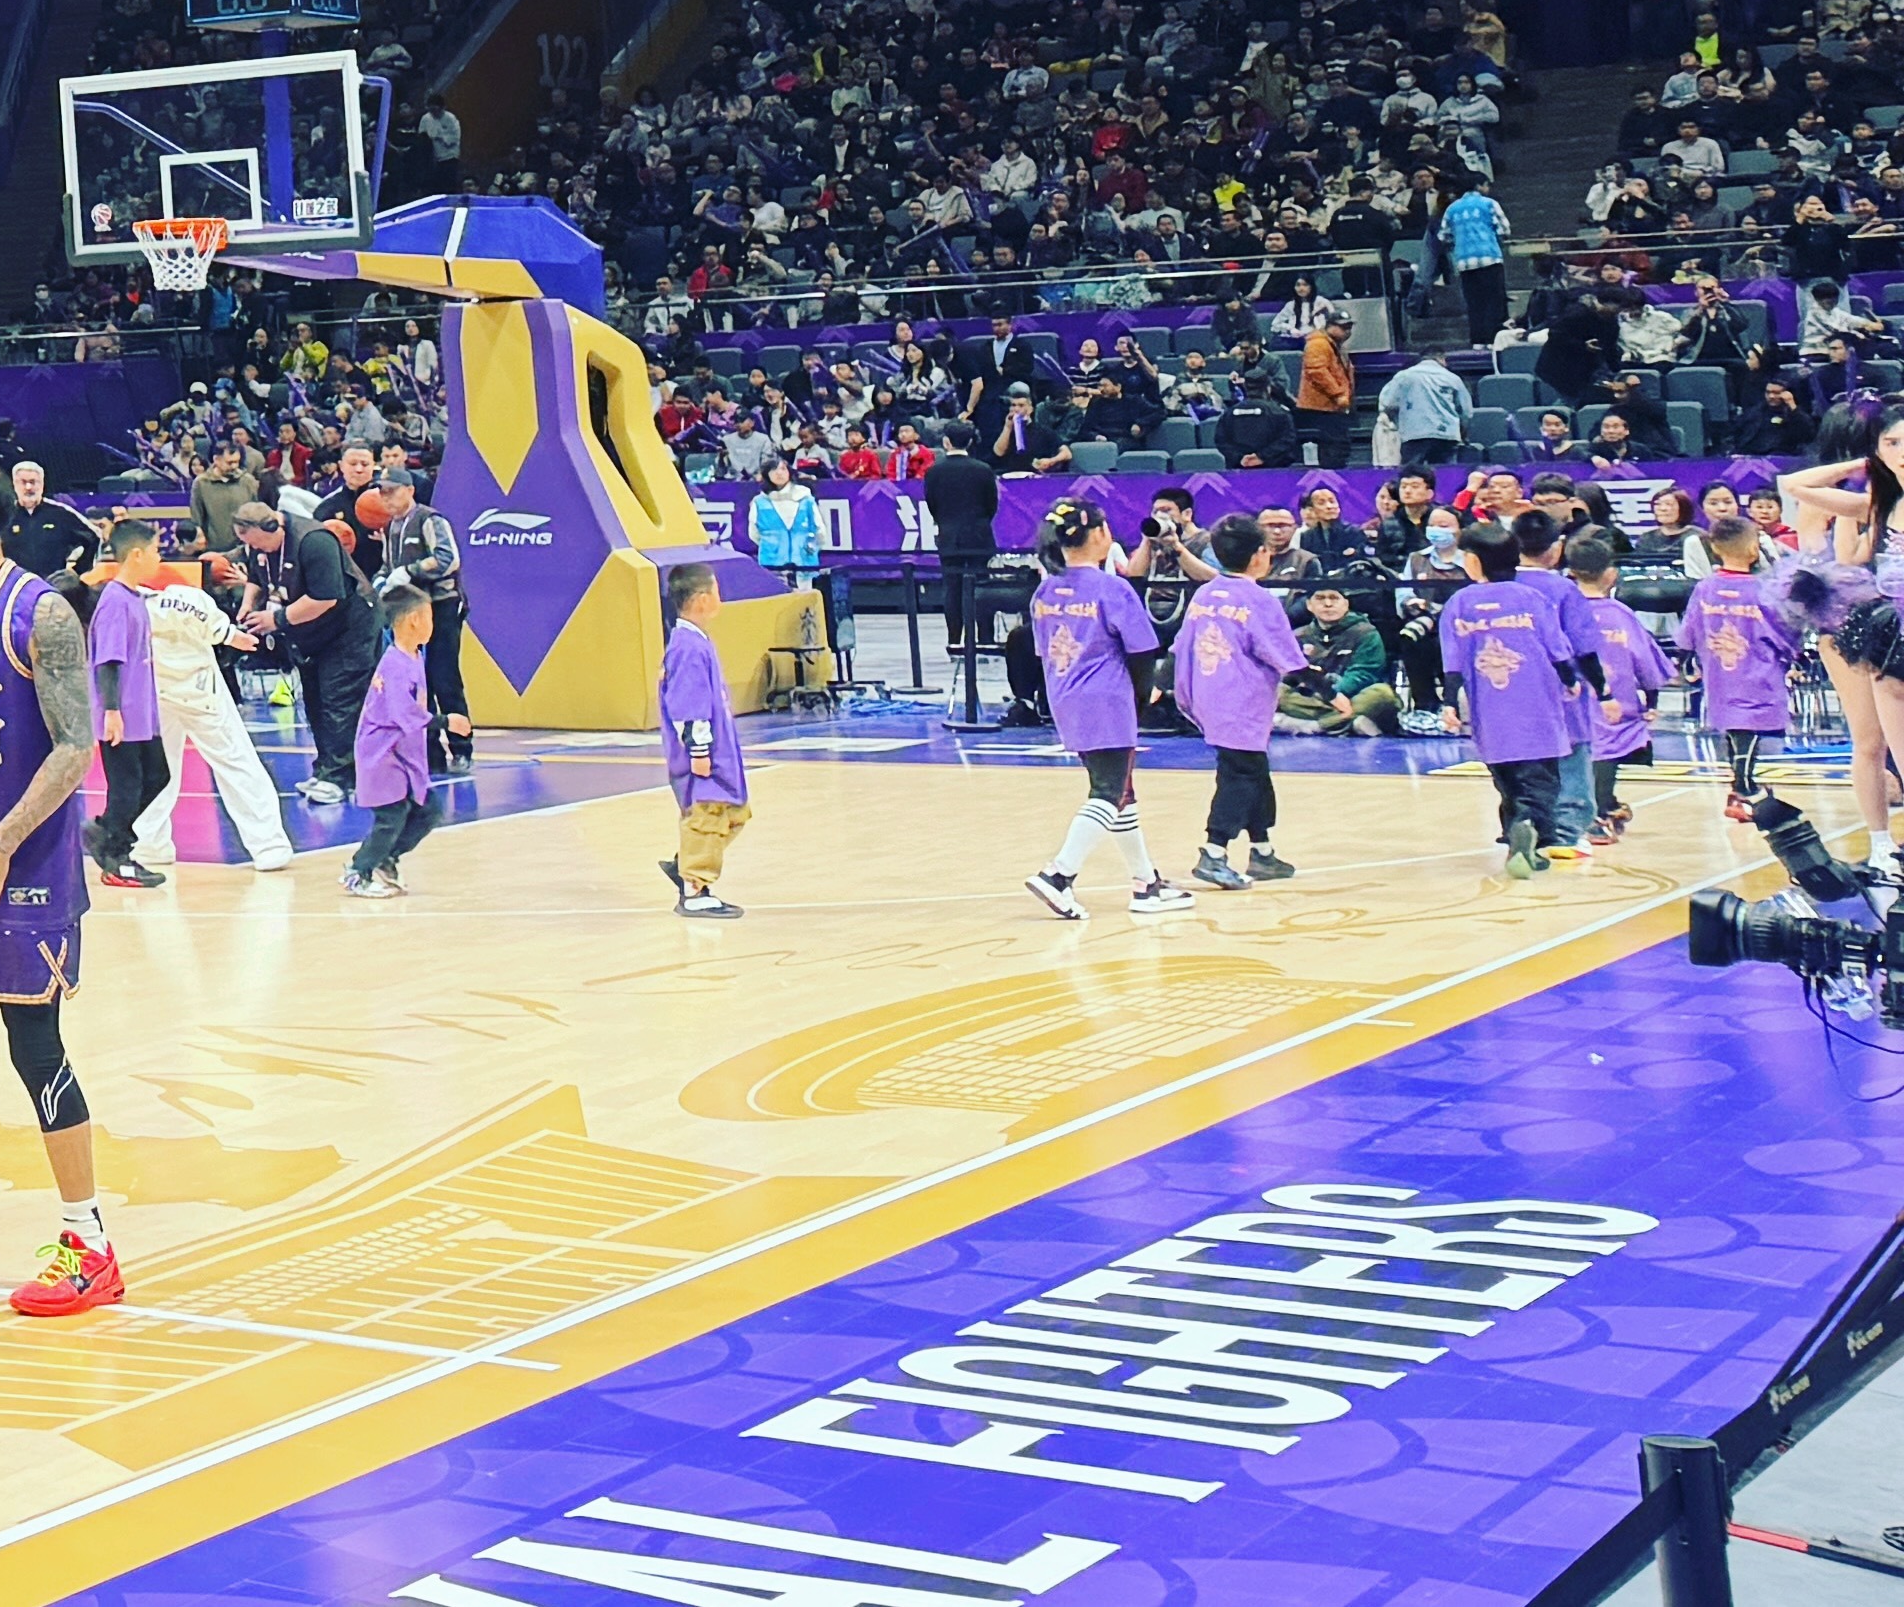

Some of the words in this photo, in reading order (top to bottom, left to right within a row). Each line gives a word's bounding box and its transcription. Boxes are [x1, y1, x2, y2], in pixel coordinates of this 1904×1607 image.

[536, 32, 590, 86] 122
[469, 530, 553, 547] LI-NING
[739, 1183, 1662, 1504] FIGHTERS
[388, 1496, 1123, 1607] AL
